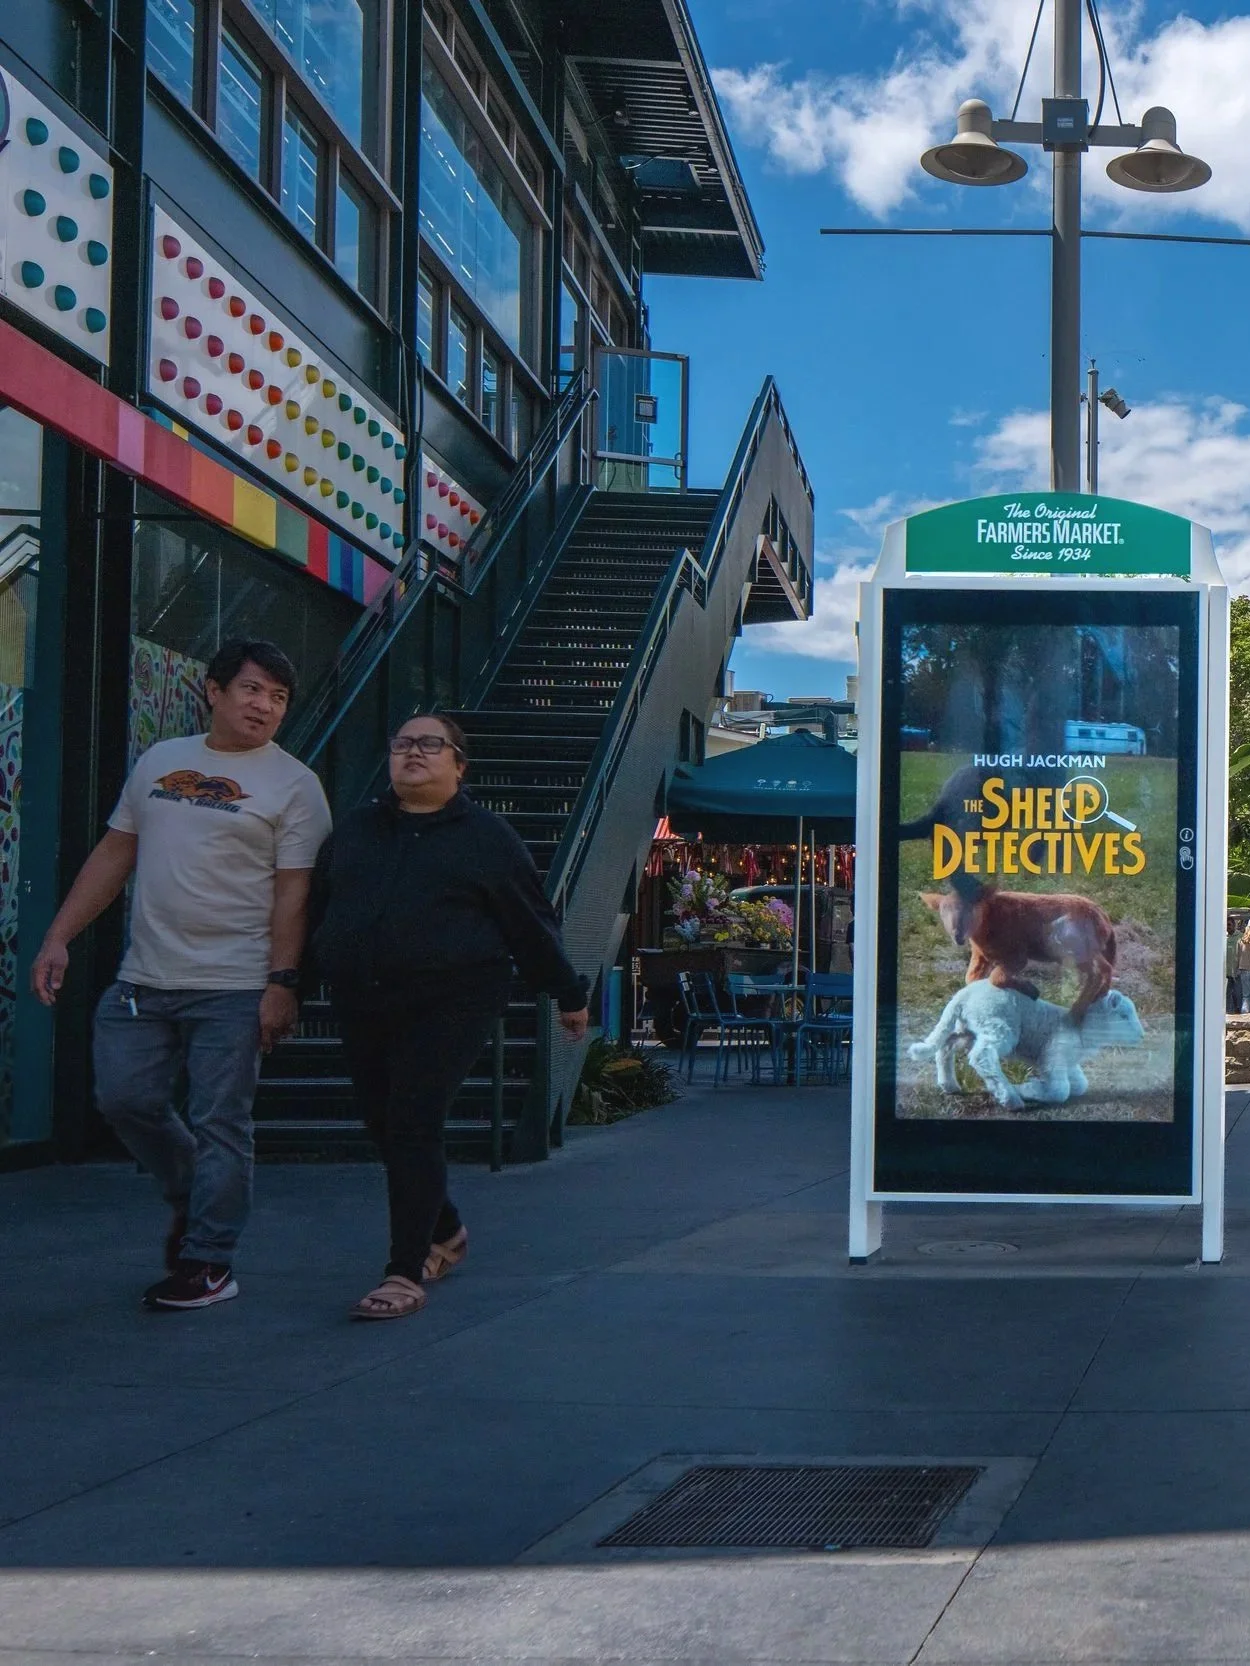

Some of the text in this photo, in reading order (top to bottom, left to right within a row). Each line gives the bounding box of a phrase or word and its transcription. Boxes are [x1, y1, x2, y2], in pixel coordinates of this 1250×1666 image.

[1004, 503, 1097, 524] The Original
[977, 519, 1050, 543] FARMERS
[1010, 545, 1091, 562] Since 1934
[973, 755, 1106, 768] HUGH JACKMAN
[963, 777, 1101, 830] THE SHEEP
[933, 823, 1147, 880] DETECTIVES
